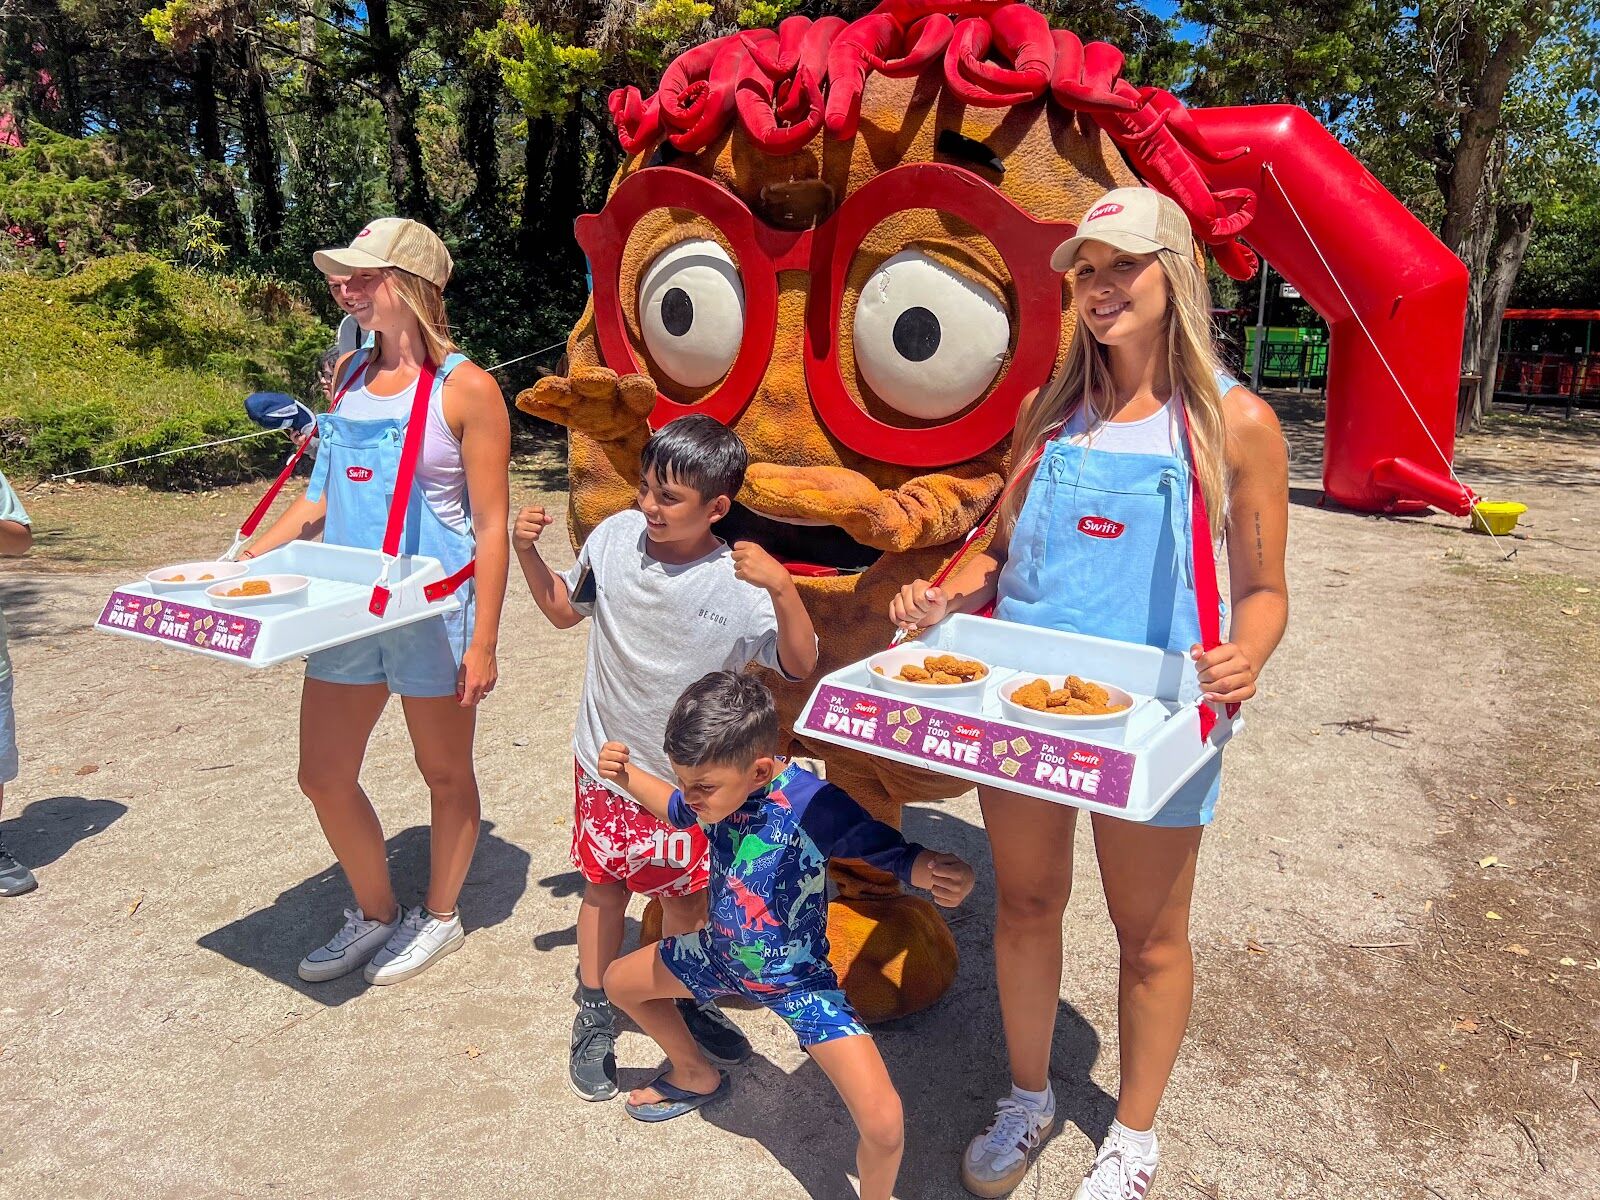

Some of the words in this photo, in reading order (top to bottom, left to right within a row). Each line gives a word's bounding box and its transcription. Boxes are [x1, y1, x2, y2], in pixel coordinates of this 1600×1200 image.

[348, 469, 368, 478] Swift
[1082, 519, 1118, 534] Swift
[127, 601, 140, 610] Swift
[108, 610, 139, 628] PATÉ
[177, 611, 191, 620] Swift
[698, 608, 708, 618] BE
[710, 612, 728, 626] COOL
[158, 620, 189, 639] PATÉ
[231, 622, 245, 632] Swift
[211, 631, 243, 651] PATÉ
[828, 704, 850, 714] TODO
[854, 702, 877, 714] Swift
[823, 712, 879, 740] PATÉ
[927, 726, 950, 738] TODO
[955, 725, 981, 738] Swift
[921, 735, 983, 766] PATÉ
[1039, 752, 1066, 765] TODO
[1071, 752, 1099, 765] Swift
[1034, 762, 1102, 795] PATÉ
[650, 828, 692, 869] 10
